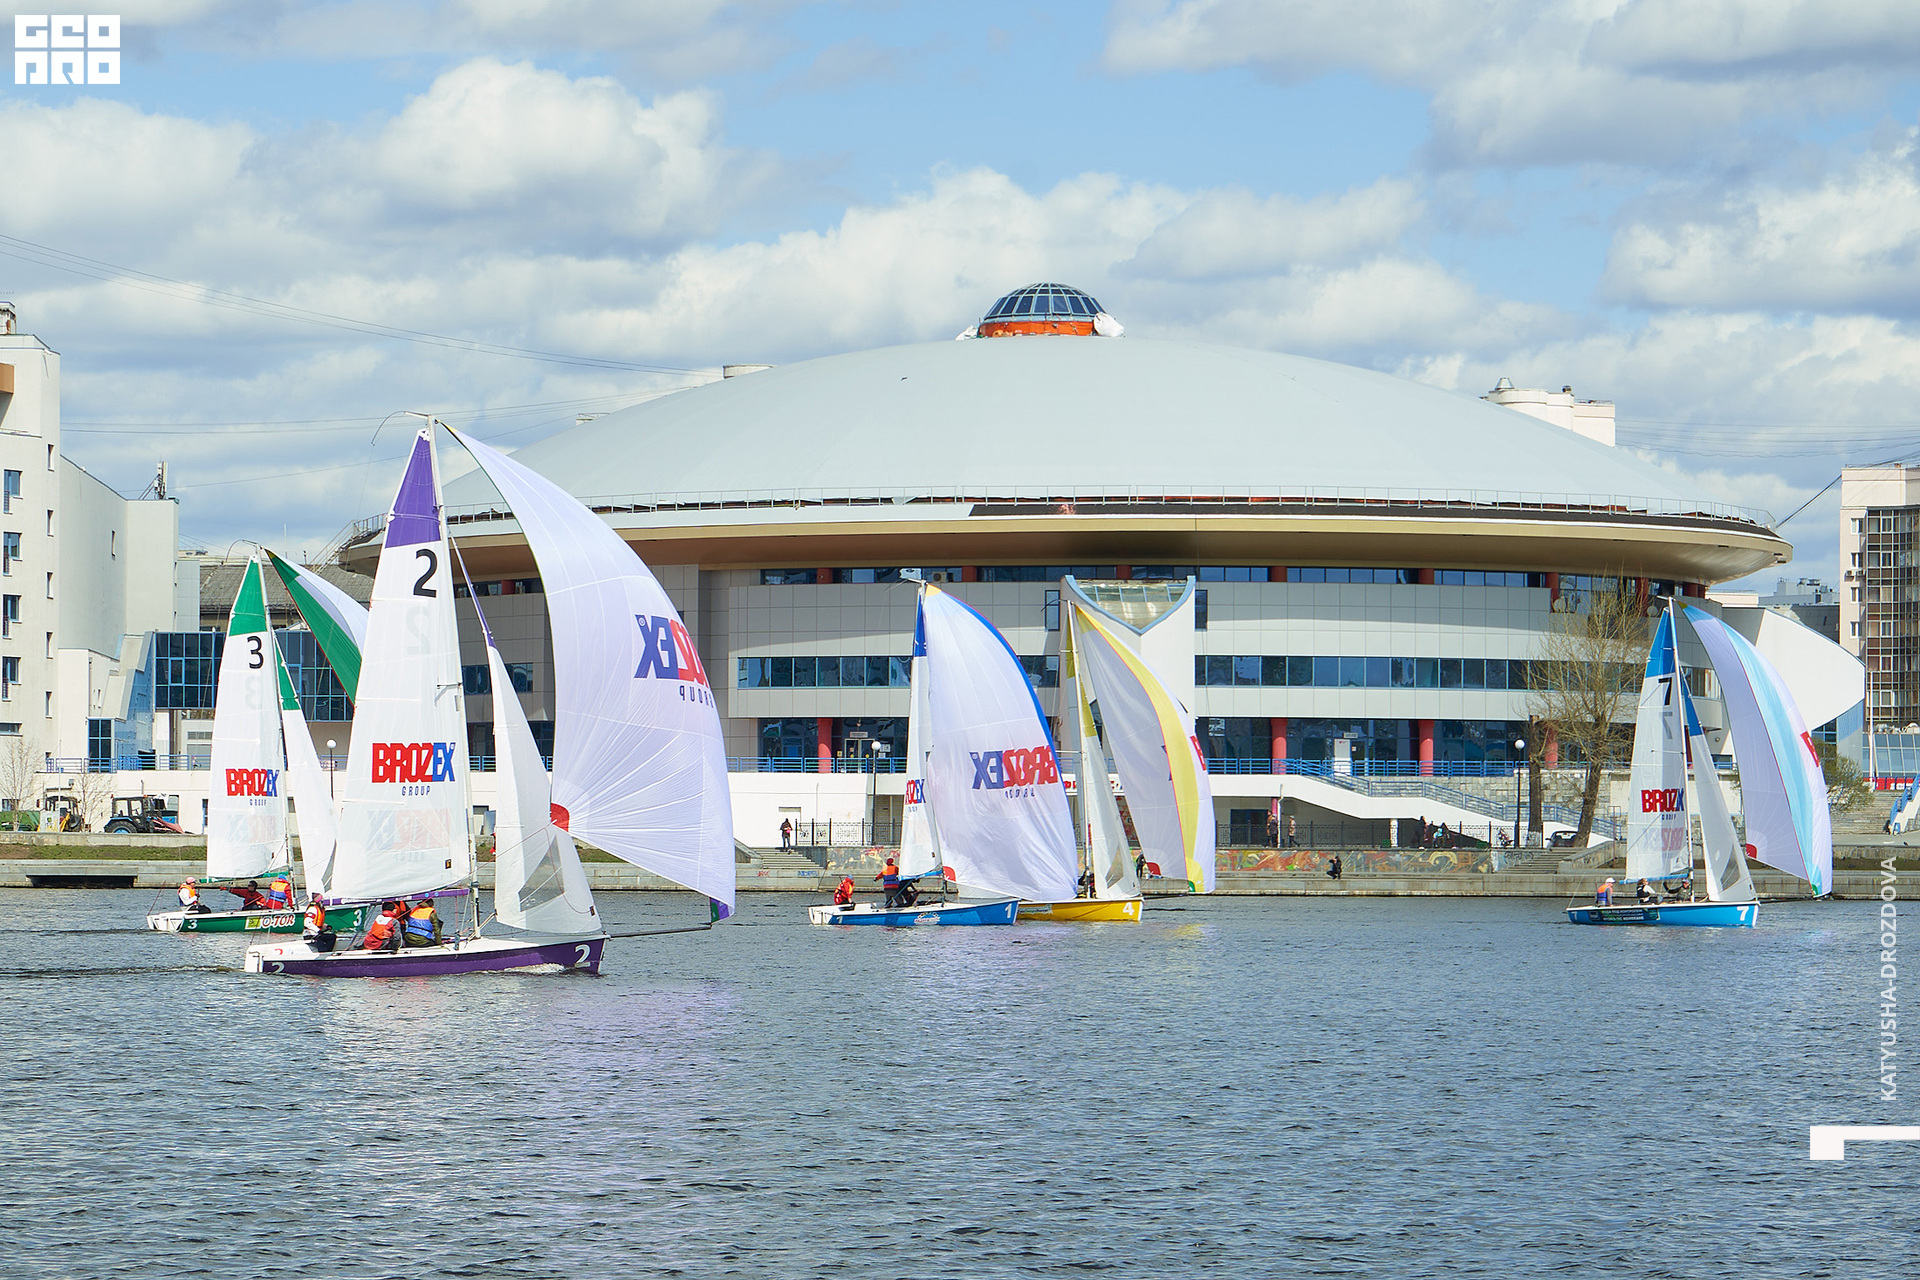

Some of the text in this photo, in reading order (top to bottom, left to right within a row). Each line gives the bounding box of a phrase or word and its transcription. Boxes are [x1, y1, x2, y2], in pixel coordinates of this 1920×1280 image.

[413, 549, 437, 598] 2
[247, 636, 264, 669] 3
[1658, 677, 1672, 706] 7
[372, 742, 456, 783] BROZEX
[226, 769, 279, 797] BROZEX
[402, 786, 431, 797] GROUP
[353, 909, 363, 927] 3
[1004, 902, 1012, 919] 1
[1122, 902, 1135, 916] 4
[1737, 906, 1750, 921] 7
[188, 919, 198, 930] 3
[574, 944, 591, 968] 2
[271, 961, 285, 973] 2
